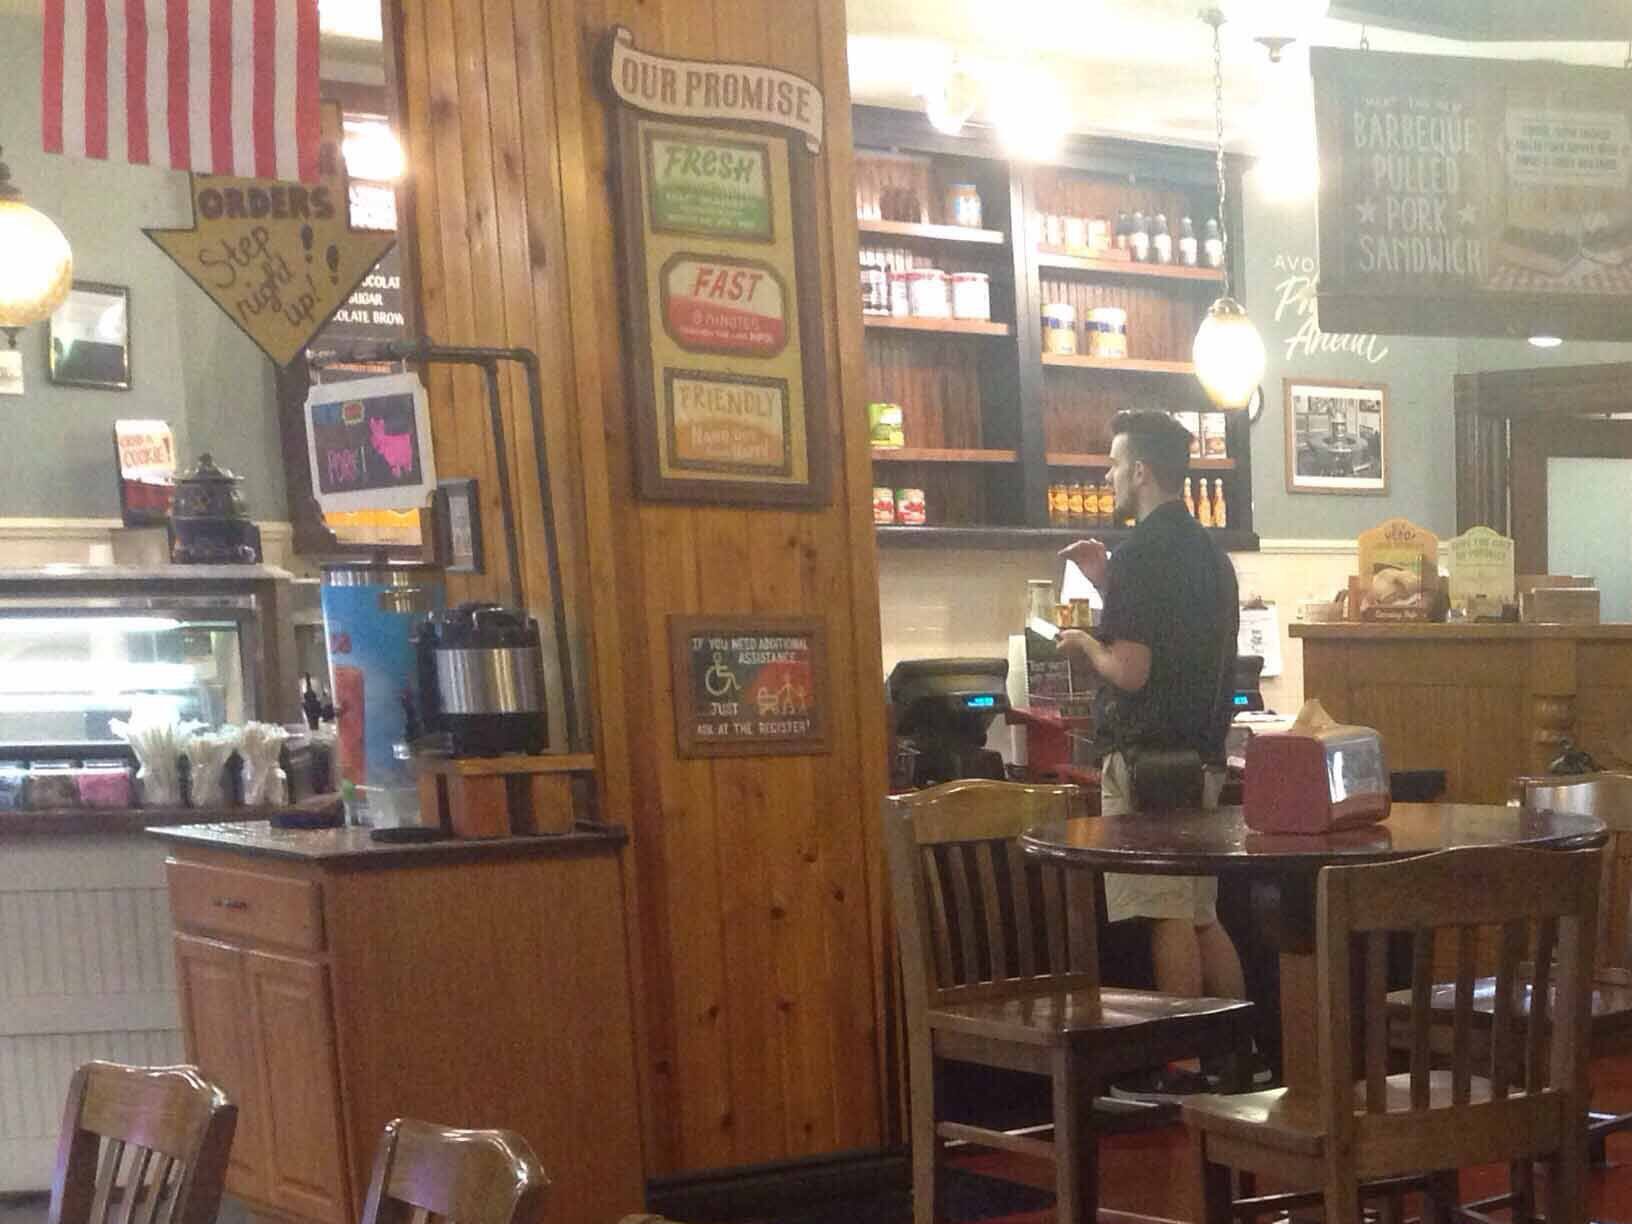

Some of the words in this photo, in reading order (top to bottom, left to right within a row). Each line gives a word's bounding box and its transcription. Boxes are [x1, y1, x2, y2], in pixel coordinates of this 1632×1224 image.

[621, 56, 678, 105] OUR
[685, 70, 811, 125] PROMISE
[1374, 153, 1459, 196] PULLED
[197, 185, 337, 221] ORDERS
[1386, 194, 1449, 234] PORK
[198, 225, 271, 289] Step
[693, 265, 763, 304] FAST
[679, 384, 778, 418] FRIENDLY
[731, 638, 757, 650] NEED
[718, 723, 728, 735] AT
[734, 722, 753, 735] THE
